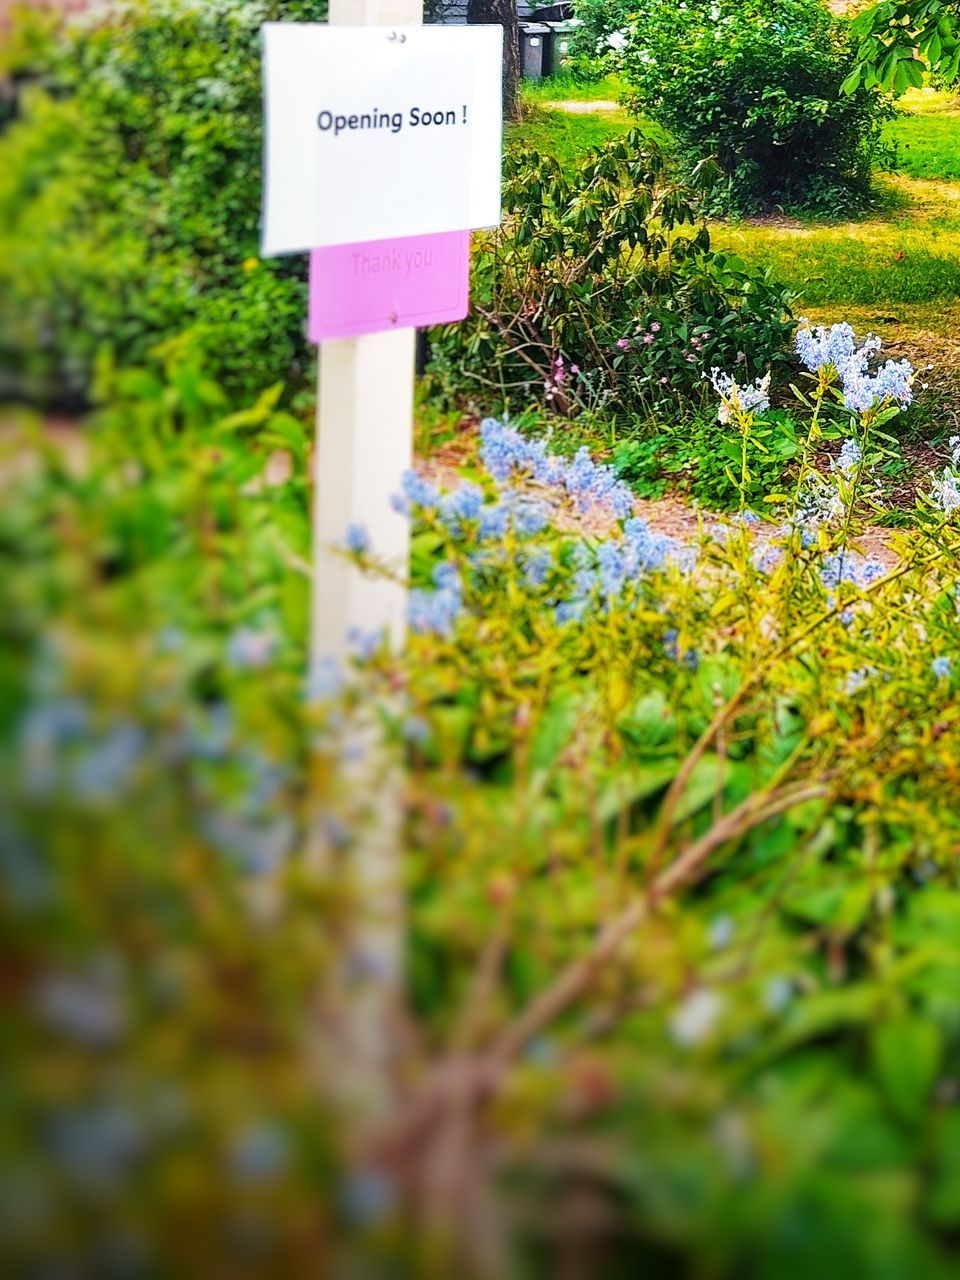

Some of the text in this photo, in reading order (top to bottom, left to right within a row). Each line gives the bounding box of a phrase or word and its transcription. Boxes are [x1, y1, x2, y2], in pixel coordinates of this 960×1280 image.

[317, 108, 403, 136] Opening
[351, 248, 433, 276] Thank you
